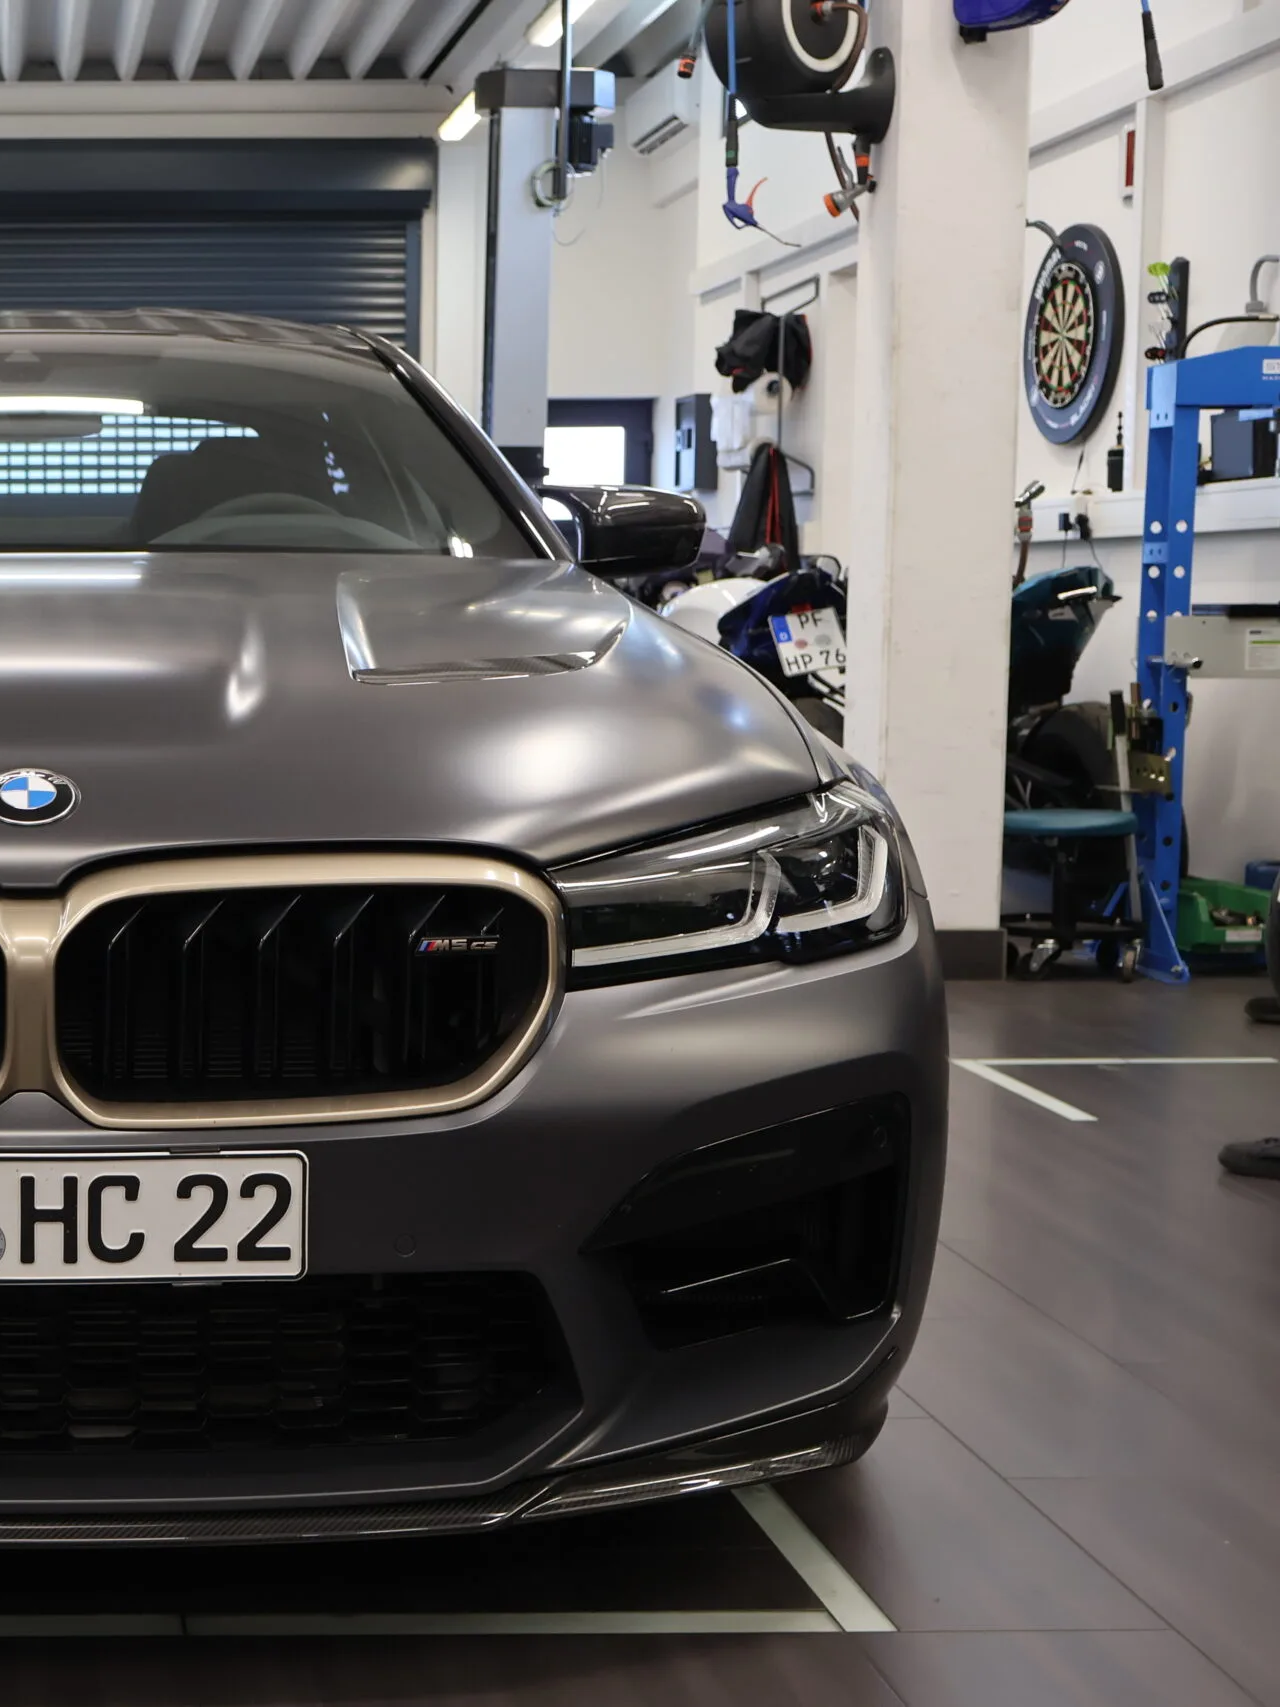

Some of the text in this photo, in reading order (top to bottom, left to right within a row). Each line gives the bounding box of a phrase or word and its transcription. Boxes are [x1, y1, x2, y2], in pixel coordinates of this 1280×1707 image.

[797, 609, 823, 629] PF
[785, 653, 813, 672] HP
[20, 1174, 145, 1263] HC
[174, 1173, 292, 1262] 22
